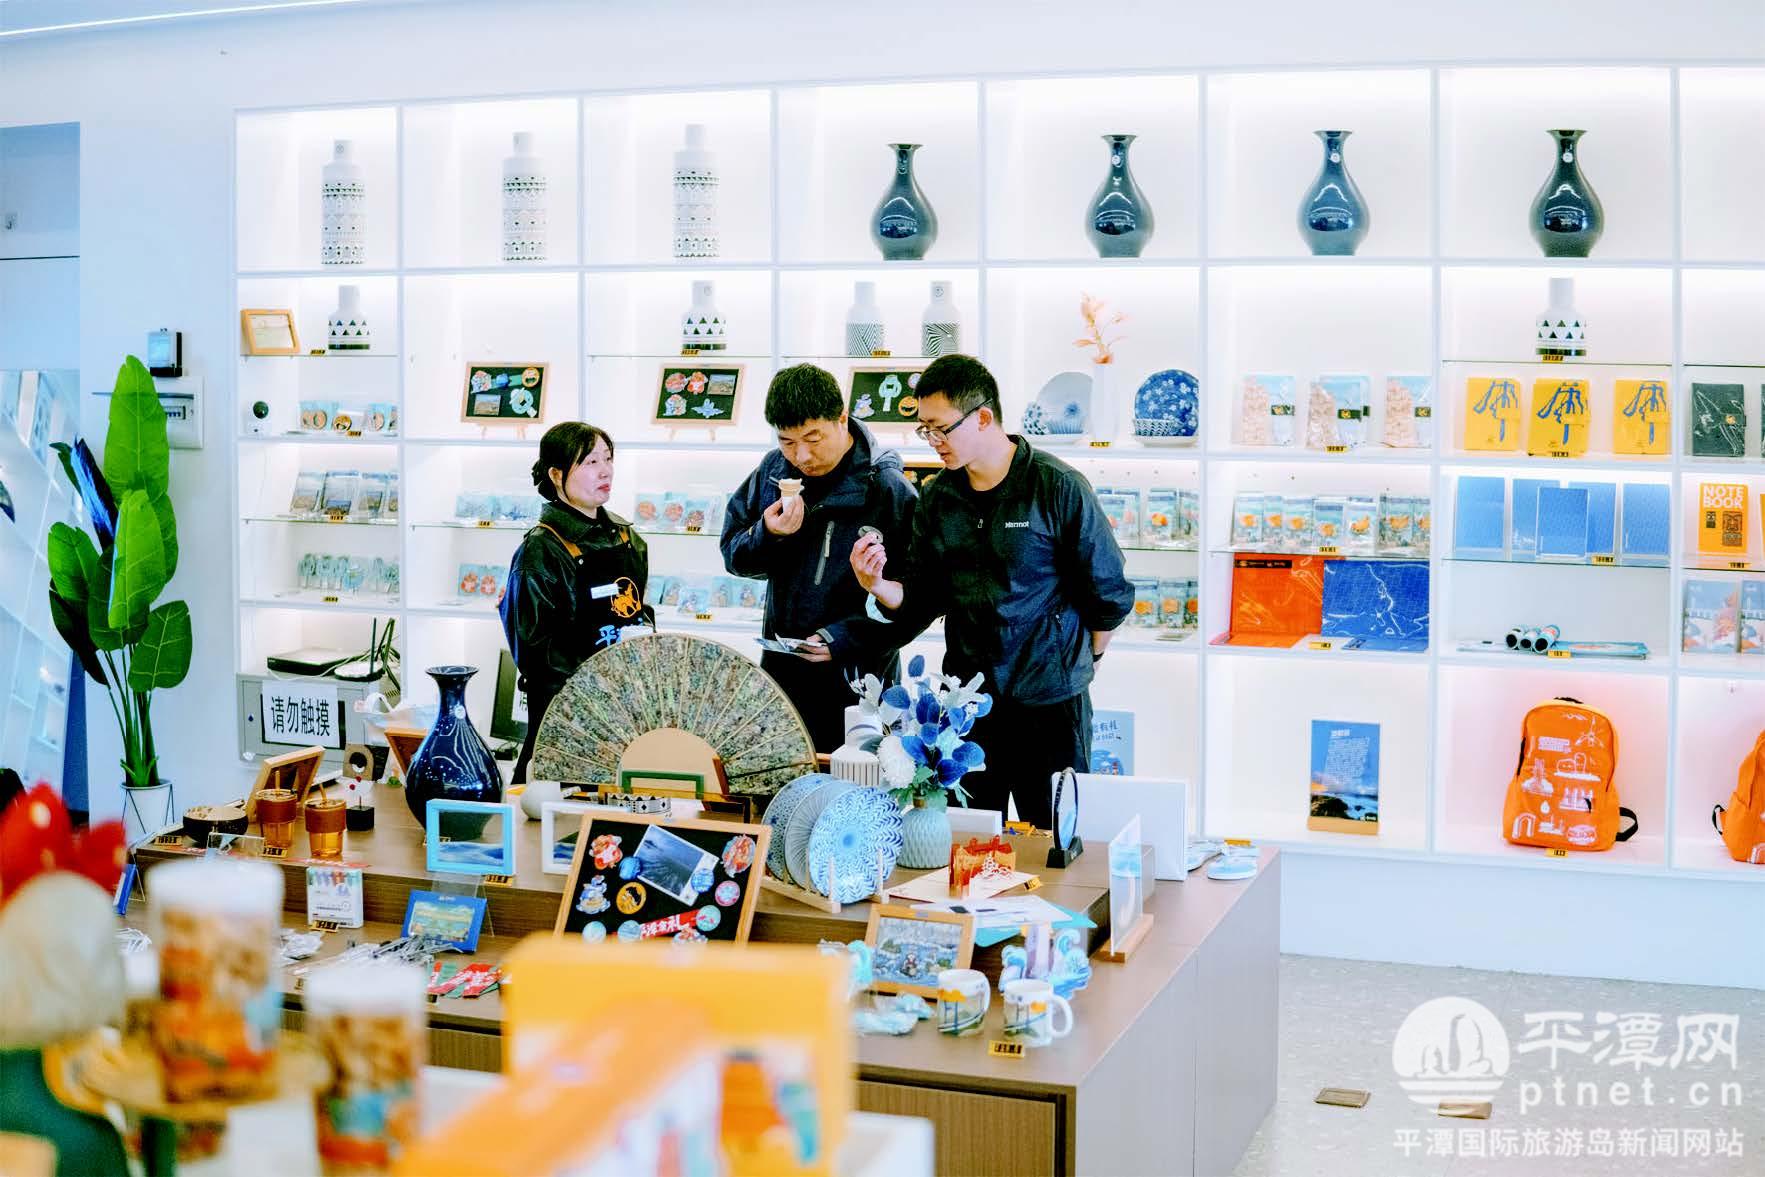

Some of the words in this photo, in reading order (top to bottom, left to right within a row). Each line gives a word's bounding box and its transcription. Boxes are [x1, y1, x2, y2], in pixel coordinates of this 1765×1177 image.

[1704, 486, 1744, 497] NOTE
[1704, 497, 1743, 509] BOOK
[271, 695, 330, 736] 请勿触摸
